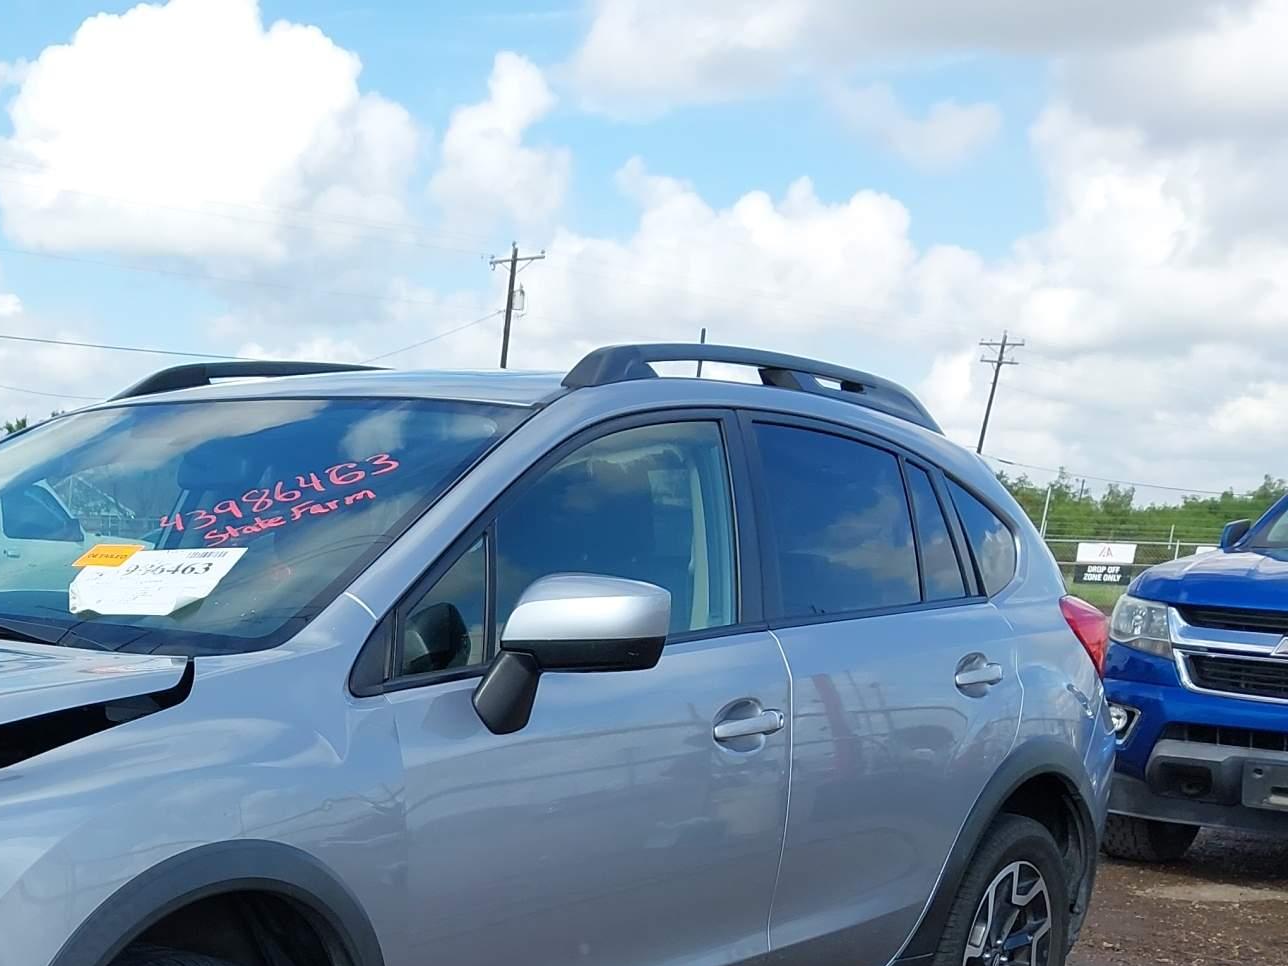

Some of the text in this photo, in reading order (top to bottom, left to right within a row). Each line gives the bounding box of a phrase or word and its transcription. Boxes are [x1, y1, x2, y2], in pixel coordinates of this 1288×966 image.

[159, 453, 400, 531] 43986463
[204, 489, 376, 547] State Farm
[1083, 573, 1122, 582] ZONE ONLY
[1087, 565, 1121, 574] DROP OFF
